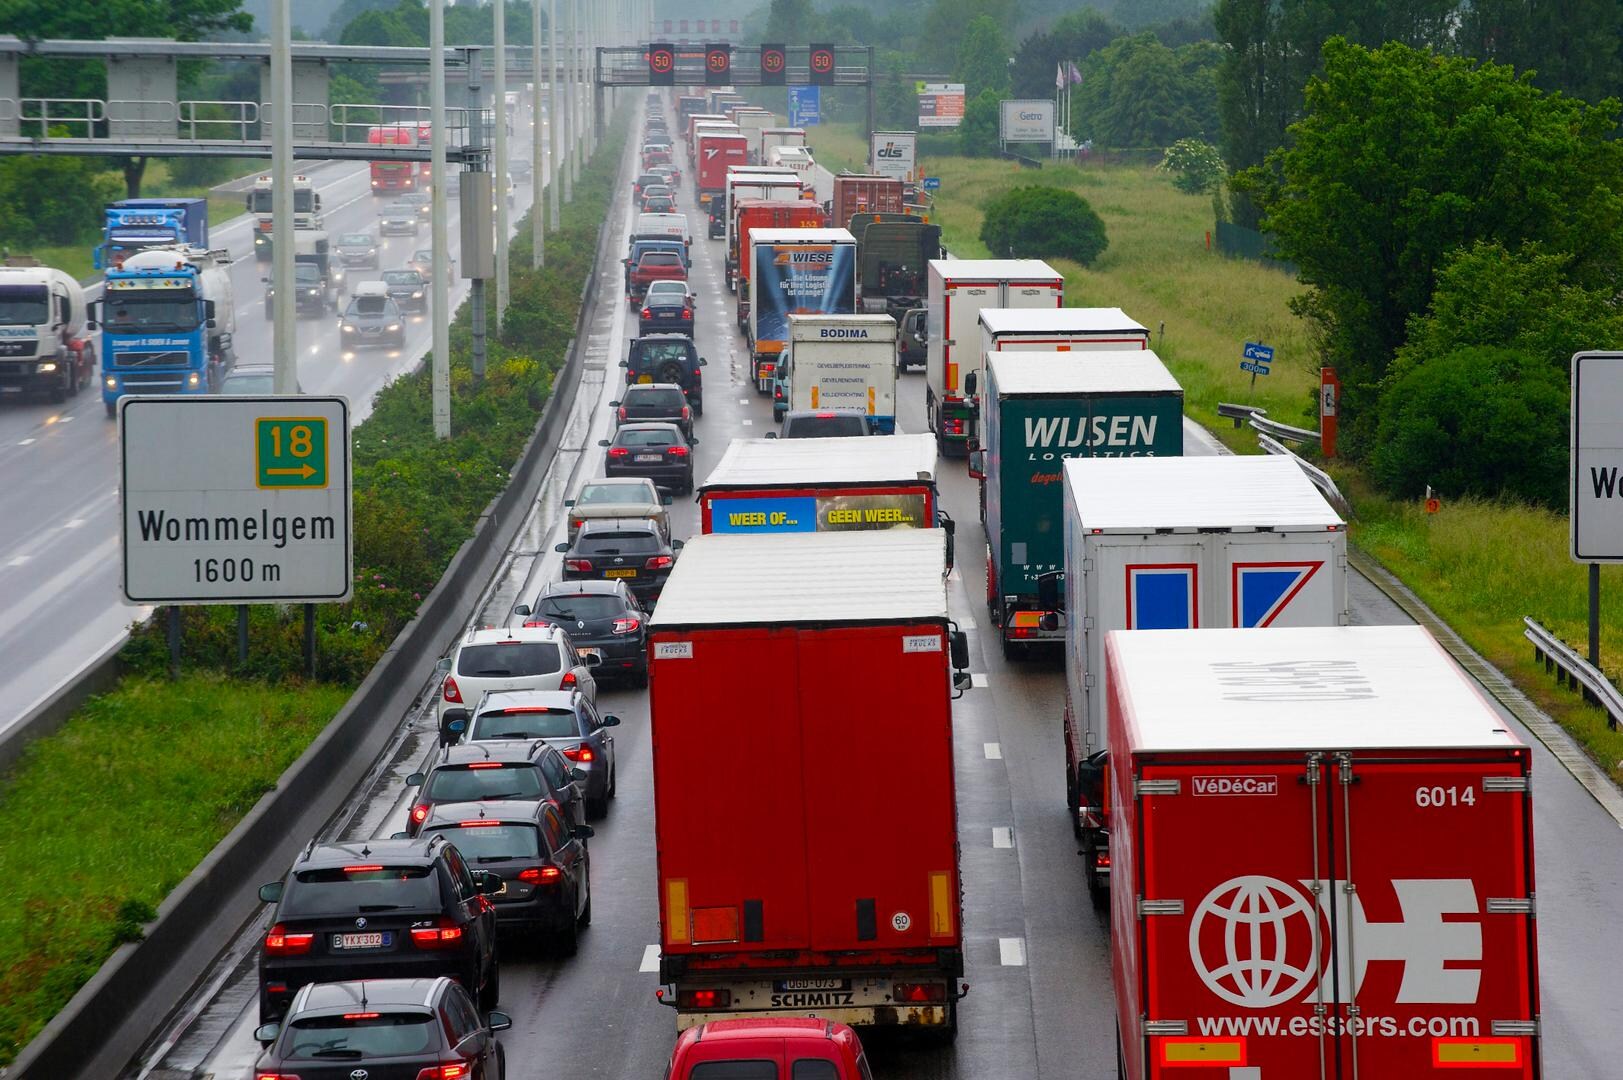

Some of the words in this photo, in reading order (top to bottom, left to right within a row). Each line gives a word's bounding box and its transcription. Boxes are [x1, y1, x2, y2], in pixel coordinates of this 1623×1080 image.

[655, 56, 669, 67] 50
[711, 56, 725, 67] 50
[766, 56, 780, 67] 50
[815, 56, 829, 67] 50
[793, 253, 833, 263] WIESE
[820, 329, 868, 338] BODIMA
[1024, 415, 1158, 448] WIJSEN
[271, 425, 313, 458] 18
[729, 512, 767, 525] WEER
[827, 510, 862, 524] GEEN
[138, 508, 335, 549] Wommelgem
[194, 557, 254, 583] 1600
[262, 563, 281, 582] m
[1194, 778, 1276, 793] VéDéCar
[1416, 786, 1476, 807] 6014
[895, 915, 908, 925] 60
[771, 992, 855, 1007] SCHMITZ
[1197, 1016, 1480, 1037] www.essers.com
